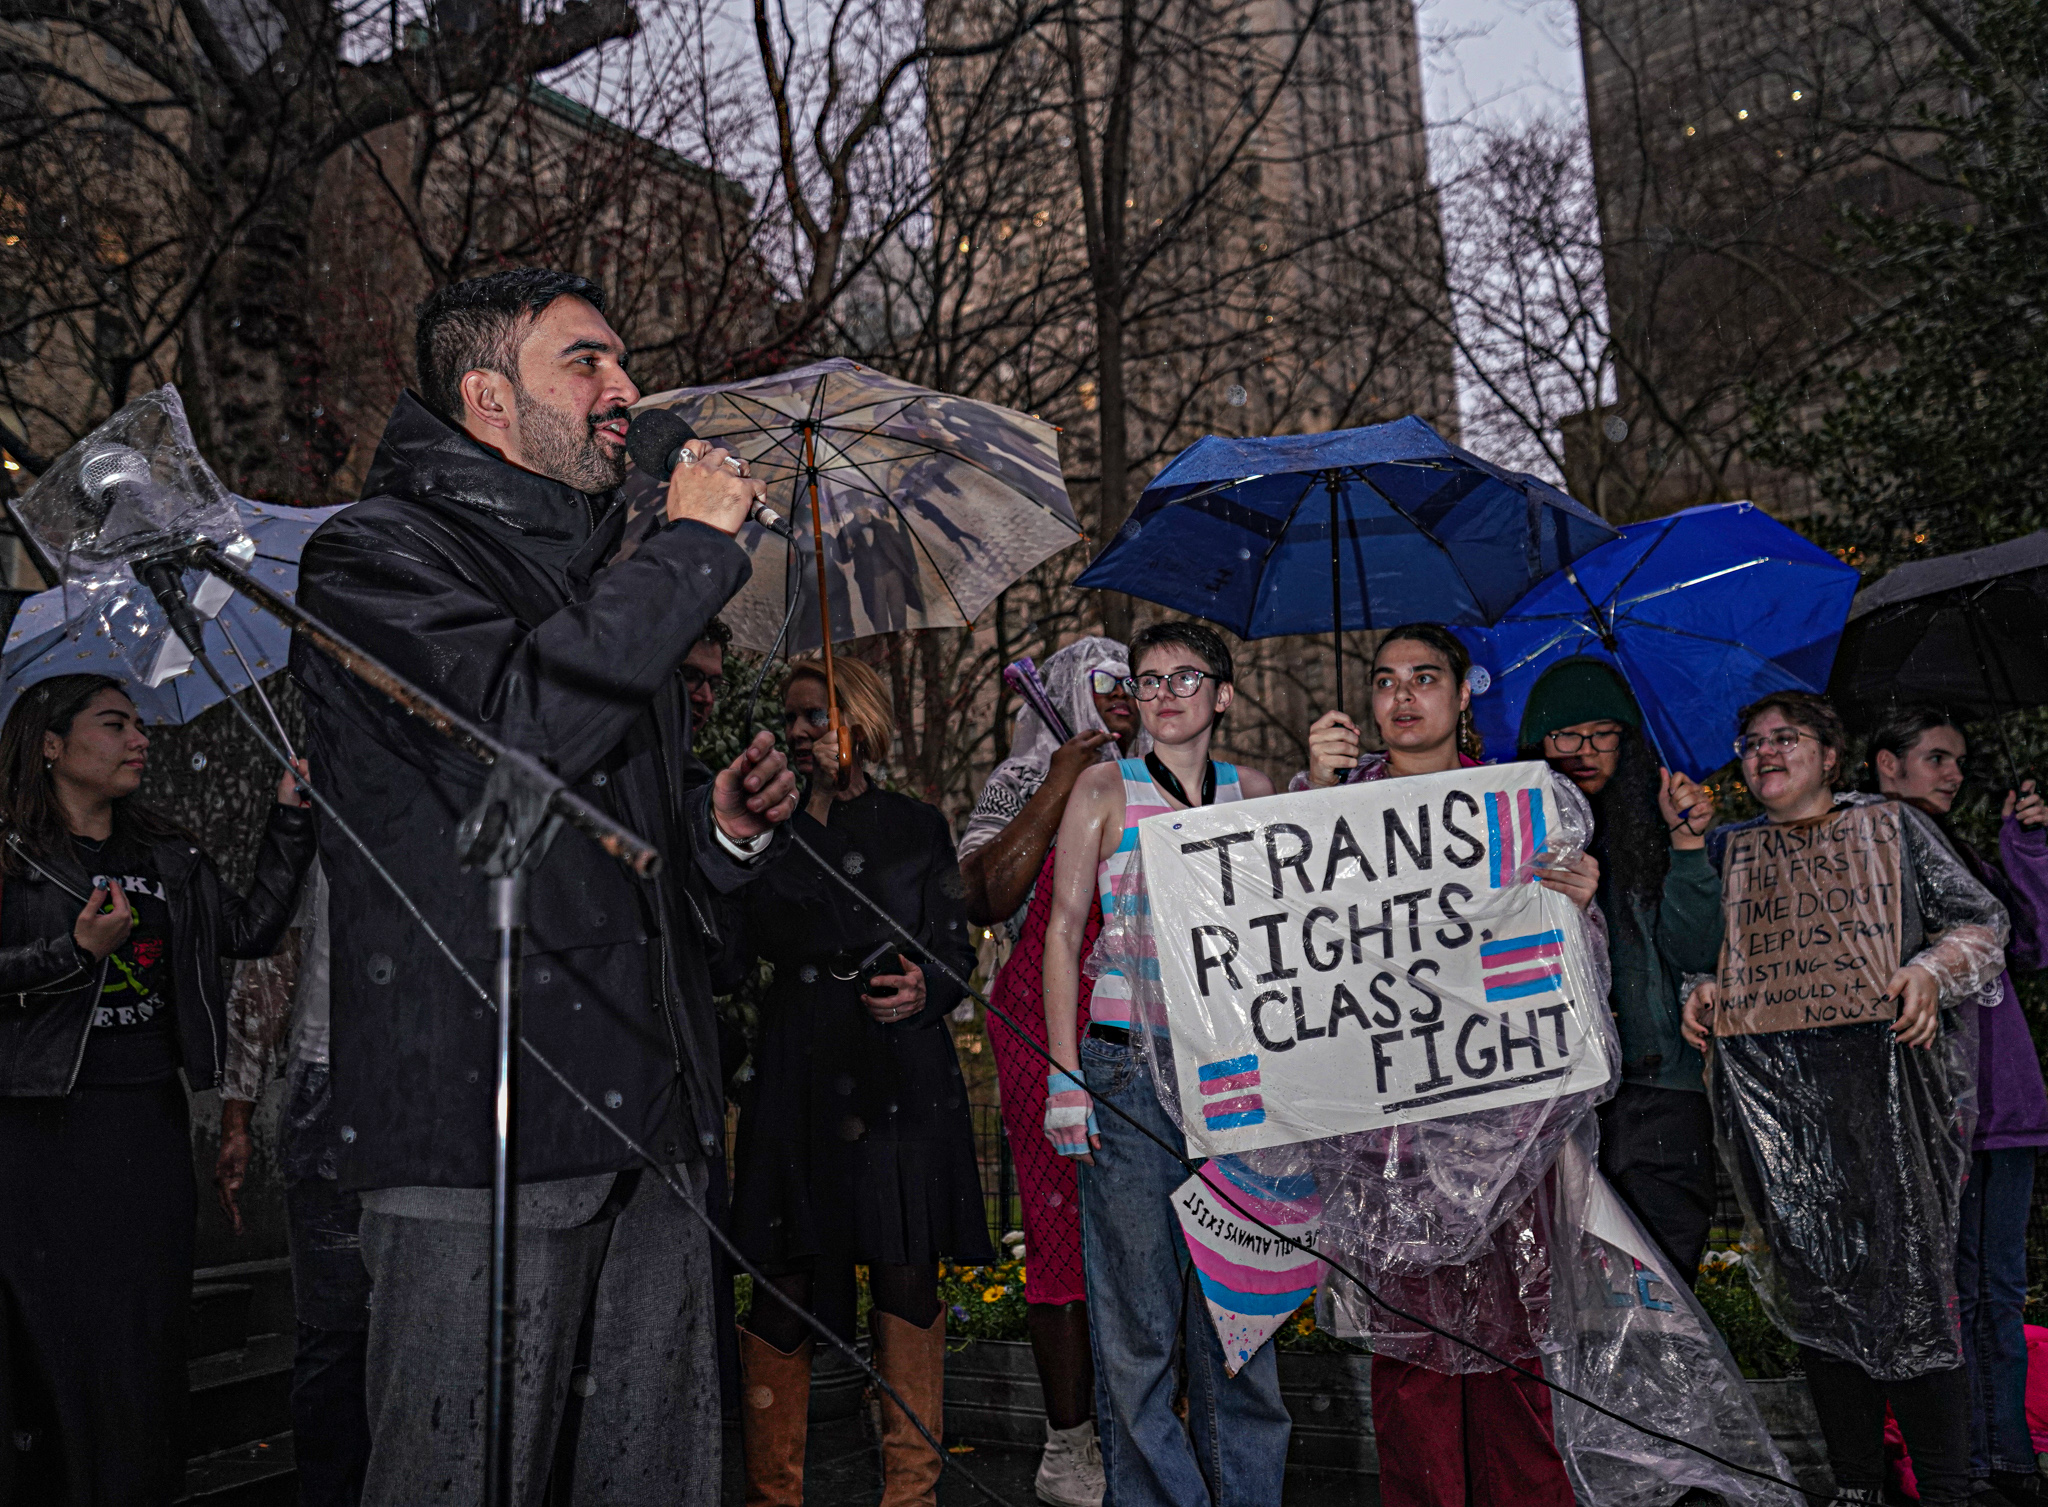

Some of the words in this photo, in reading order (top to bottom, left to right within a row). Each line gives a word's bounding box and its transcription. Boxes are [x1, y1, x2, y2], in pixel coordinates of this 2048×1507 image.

[1181, 789, 1487, 906] TRANS
[1732, 816, 1854, 864] ERASING
[1859, 813, 1897, 844] US
[1730, 863, 1778, 894] THE
[1790, 850, 1870, 883] FIRST
[1727, 896, 1790, 929] TIME
[1191, 882, 1493, 996] RIGHTS.
[1726, 929, 1795, 962] KEEP
[1798, 923, 1832, 948] US
[1837, 920, 1895, 943] FROM
[1721, 957, 1829, 989] EXISTING
[1833, 953, 1868, 972] SO
[1250, 959, 1442, 1053] CLASS
[1721, 991, 1759, 1012] WHY
[1764, 983, 1837, 1006] WOULD
[1370, 1001, 1576, 1095] FIGHT
[1182, 1192, 1225, 1238] EXIST
[1223, 1222, 1273, 1256] ALWAYS
